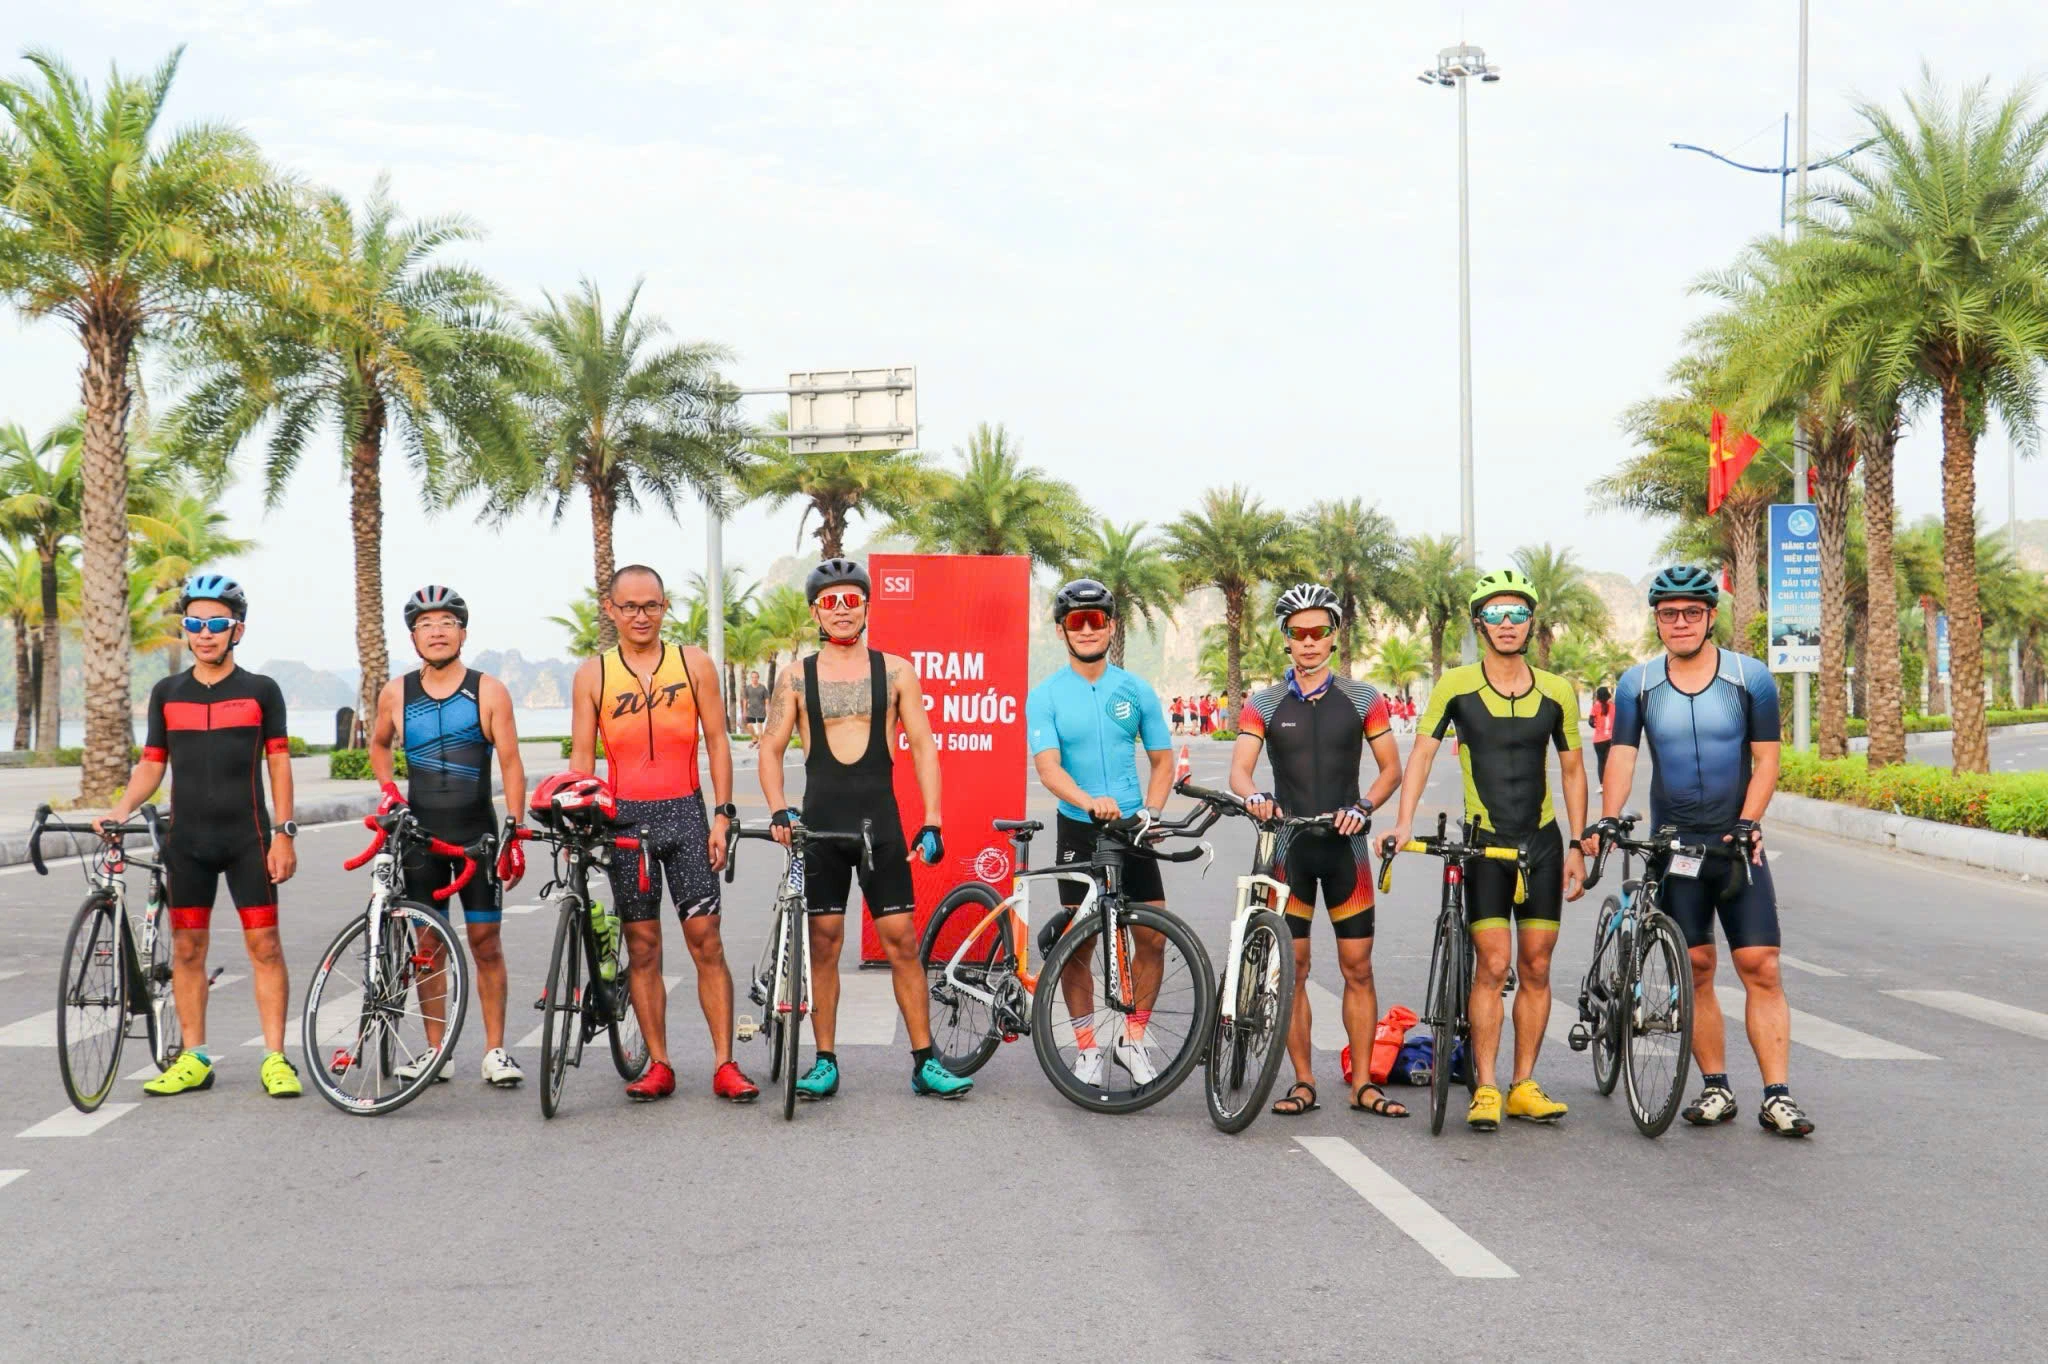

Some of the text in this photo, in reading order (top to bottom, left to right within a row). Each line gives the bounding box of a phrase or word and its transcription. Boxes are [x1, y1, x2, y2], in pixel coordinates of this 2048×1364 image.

[884, 576, 910, 593] SSI
[911, 651, 984, 686] TRẠM
[943, 687, 1017, 724] NƯỚC
[948, 733, 992, 751] 500M
[1109, 908, 1117, 998] DIAMONDBACK
